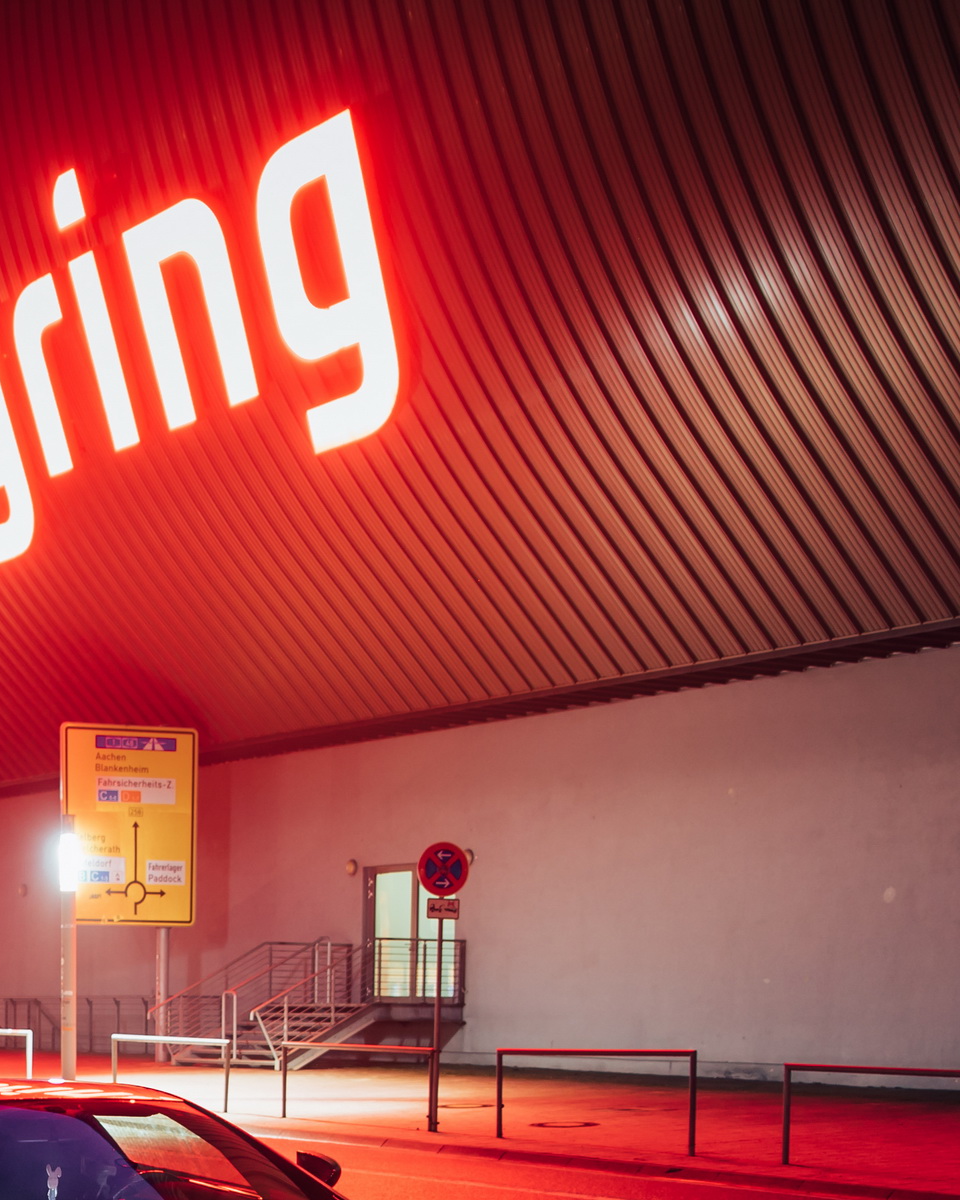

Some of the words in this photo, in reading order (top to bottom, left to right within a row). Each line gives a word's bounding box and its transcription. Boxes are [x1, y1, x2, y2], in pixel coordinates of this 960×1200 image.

[96, 752, 127, 761] Aachen
[95, 763, 149, 773] Blankenheim
[148, 863, 183, 873] Fahrerlager
[148, 874, 182, 883] Paddock
